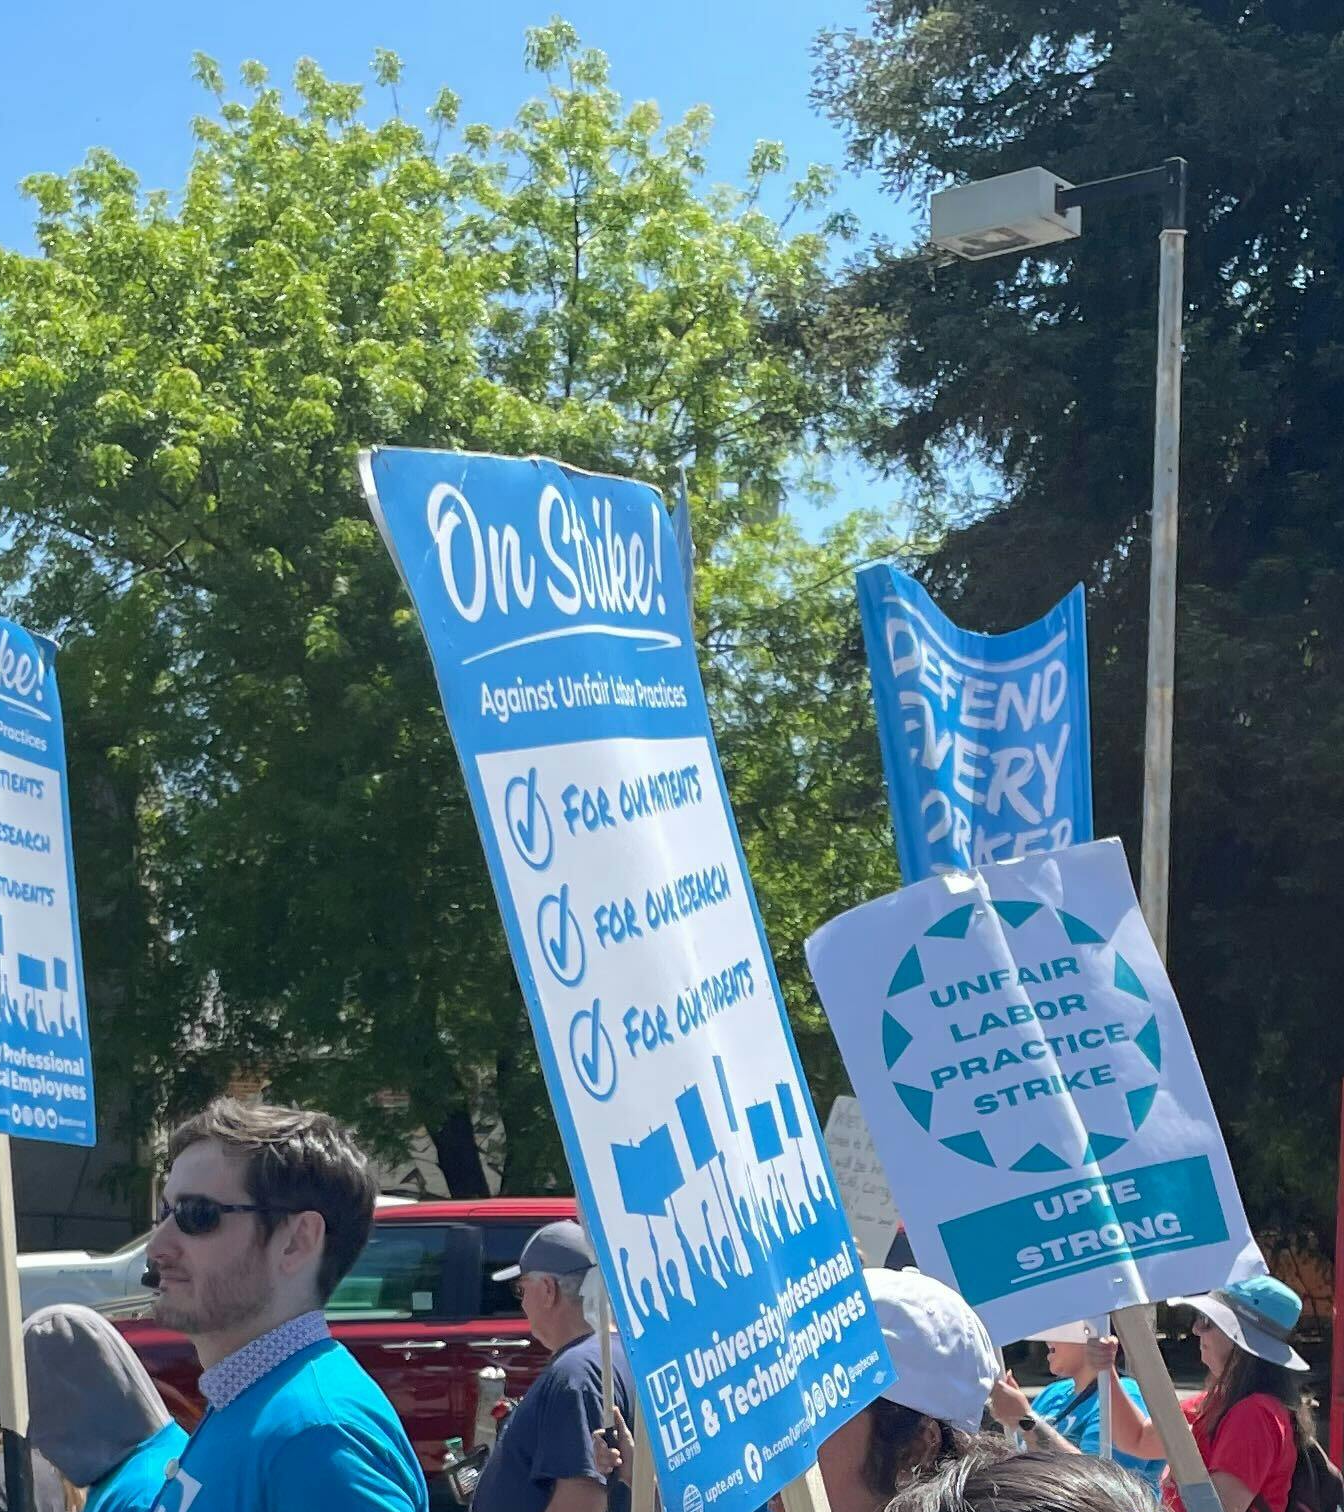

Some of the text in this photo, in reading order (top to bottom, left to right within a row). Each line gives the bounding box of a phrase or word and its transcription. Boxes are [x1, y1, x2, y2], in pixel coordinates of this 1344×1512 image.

[426, 481, 667, 623] On Strike!
[480, 671, 688, 724] Against Unfair Labor Practices
[886, 617, 1069, 733] DEFEND
[561, 763, 704, 837] FOR OUR PATIENTS
[593, 862, 732, 950] FOR OUR RESEARCH
[621, 957, 755, 1058] FOR OUR STUDENTS
[929, 956, 1081, 1009] UNFAIR
[948, 993, 1088, 1044] LABOR
[3, 1043, 86, 1078] Professional
[10, 1069, 87, 1102] Employees
[929, 1022, 1131, 1090] PRACTICE
[973, 1063, 1117, 1116] STRIKE
[1032, 1178, 1142, 1223] UPTE
[1014, 1211, 1183, 1272] STRONG
[684, 1241, 855, 1390] University Professional
[699, 1398, 721, 1438] &
[789, 1290, 867, 1369] Employees
[704, 1468, 745, 1503] upte.org
